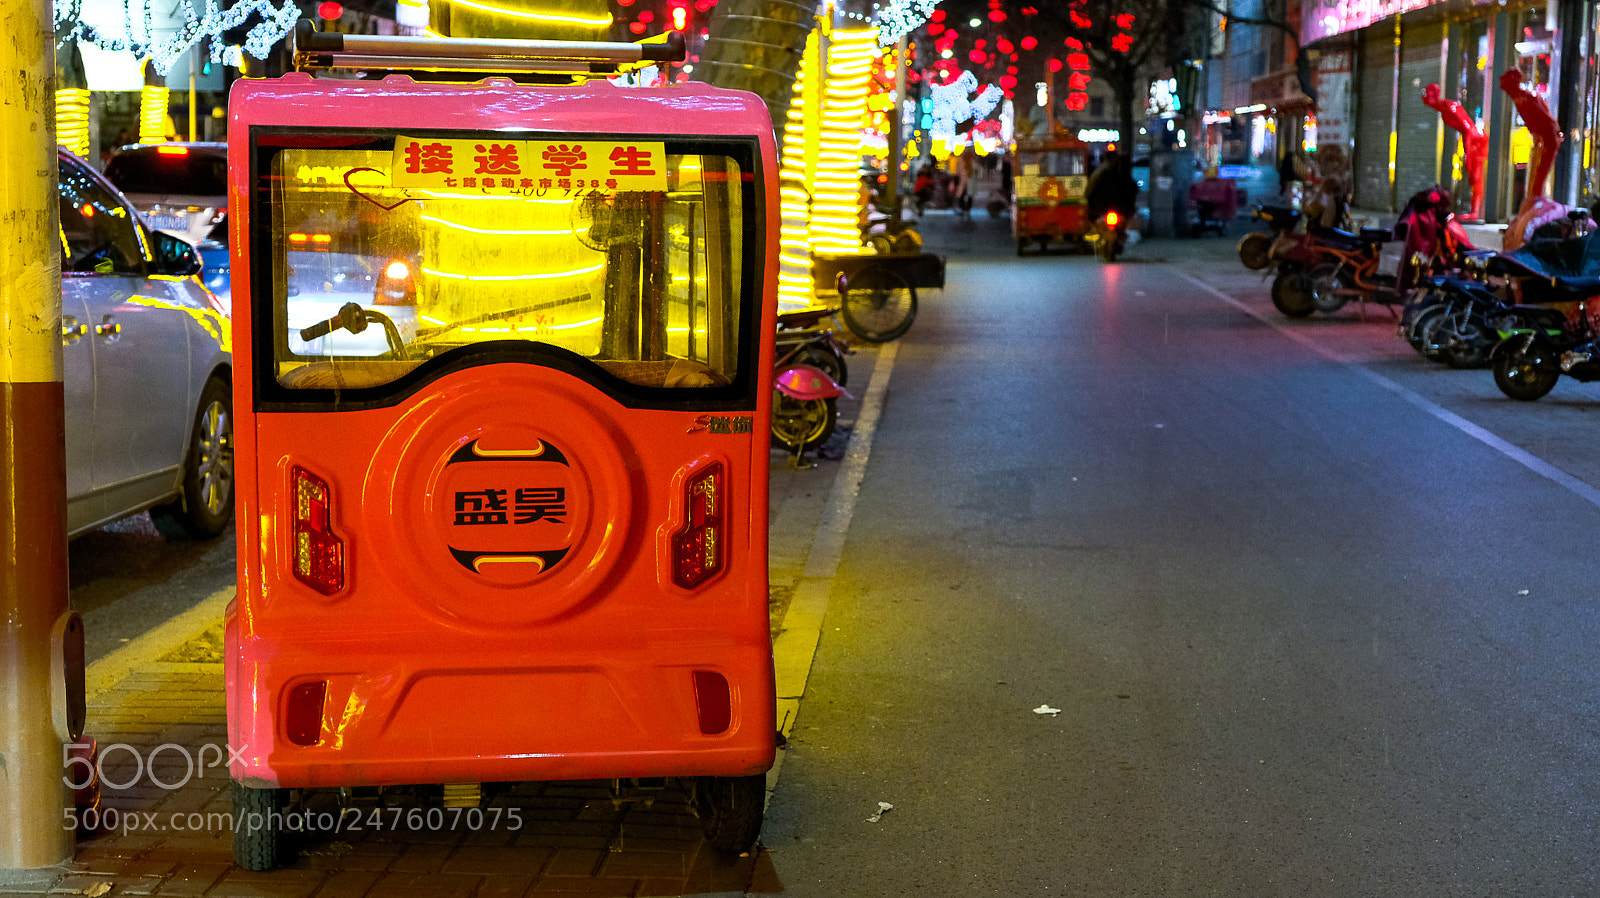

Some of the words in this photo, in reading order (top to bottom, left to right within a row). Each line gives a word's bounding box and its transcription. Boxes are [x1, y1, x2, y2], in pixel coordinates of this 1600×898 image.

[405, 142, 655, 176] 接送学生
[444, 177, 618, 188] 七路电动车市场38号
[453, 487, 567, 525] 盛昊
